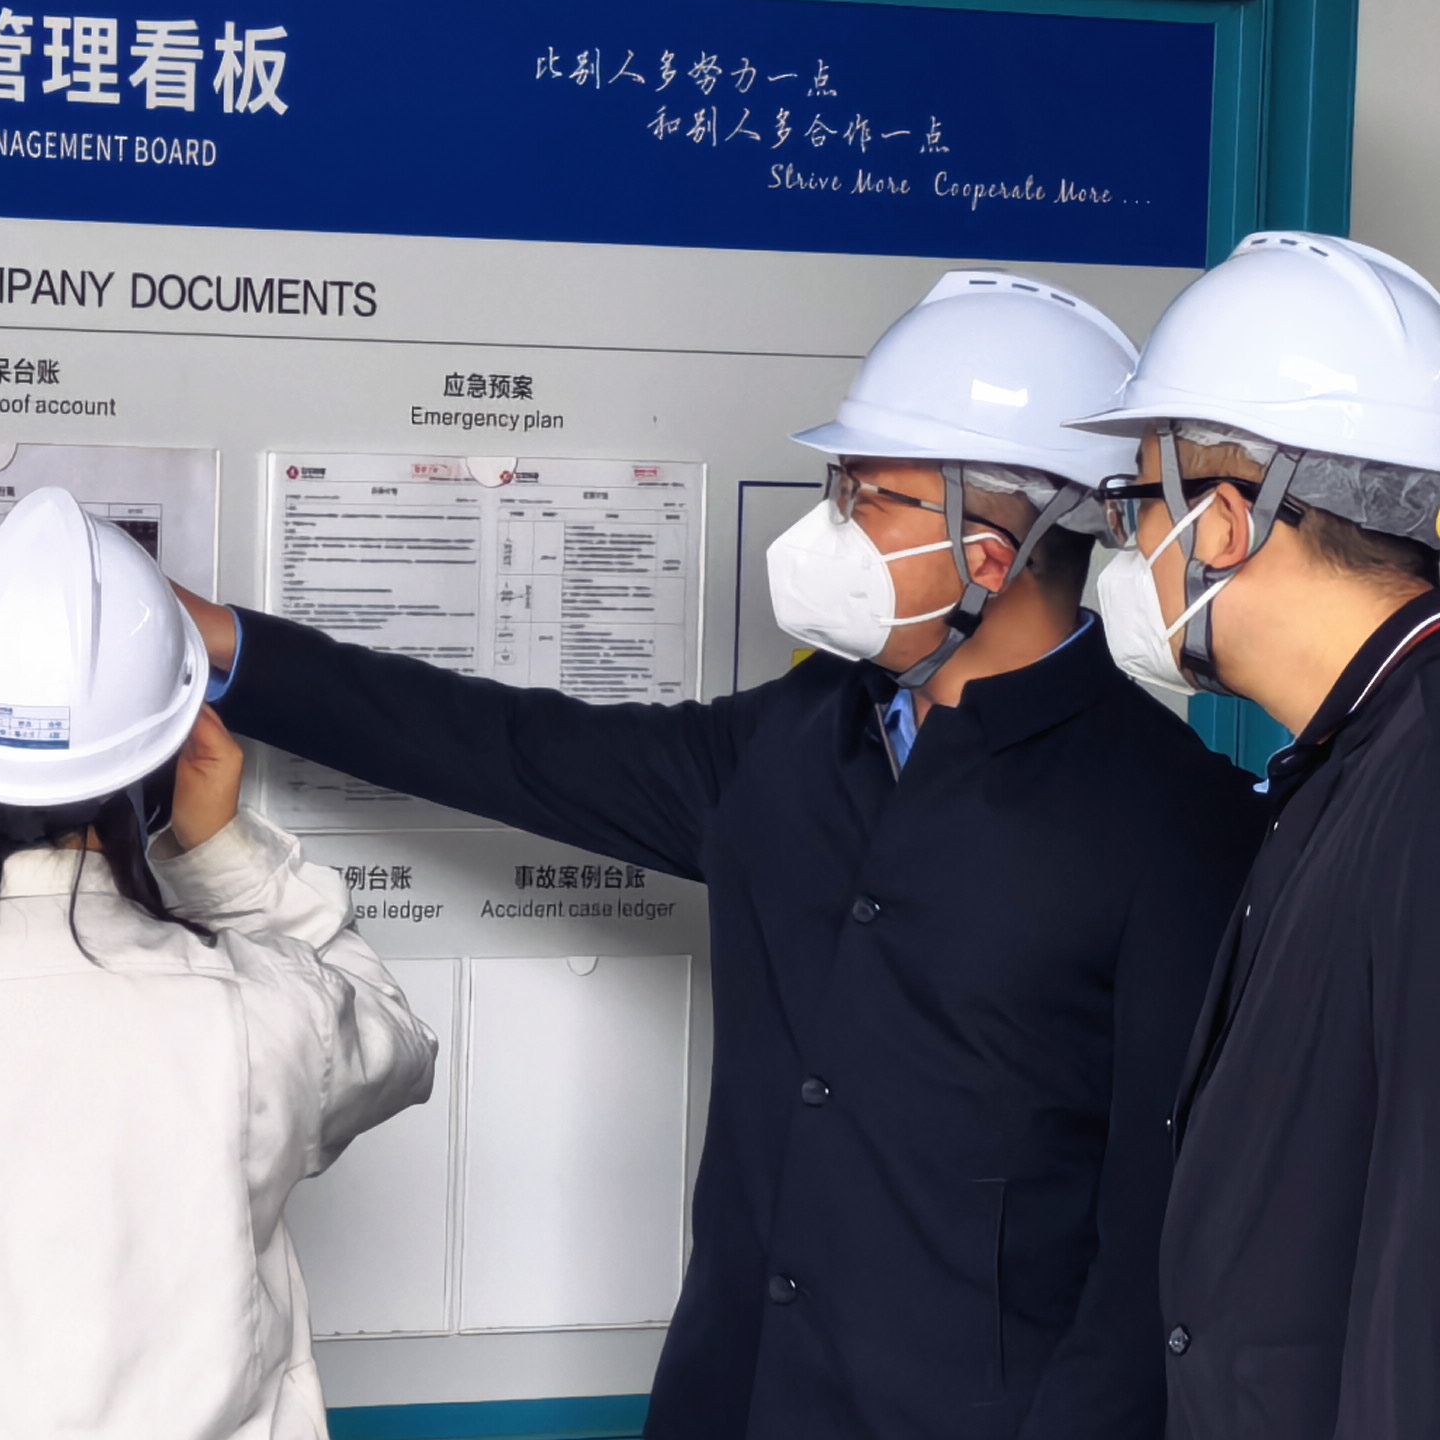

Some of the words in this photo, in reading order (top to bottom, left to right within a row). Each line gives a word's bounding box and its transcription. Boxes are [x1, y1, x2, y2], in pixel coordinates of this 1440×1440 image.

[535, 46, 838, 98] 比别人多努力一点
[647, 105, 951, 154] 和别人多合作一点
[134, 135, 218, 167] BOARD
[767, 163, 842, 191] Strive
[850, 168, 911, 195] More
[934, 171, 1046, 210] Cooperate
[1053, 176, 1113, 205] More
[130, 273, 378, 318] DOCUMENTS
[443, 372, 534, 400] 应急预案
[36, 397, 117, 418] account
[411, 406, 520, 431] Emergency
[524, 410, 564, 432] plan
[331, 865, 413, 892] 例台账
[515, 864, 646, 891] 事故案例台账
[382, 900, 444, 922] ledger
[481, 898, 566, 919] Accident
[569, 902, 613, 919] case
[617, 899, 677, 922] ledger
